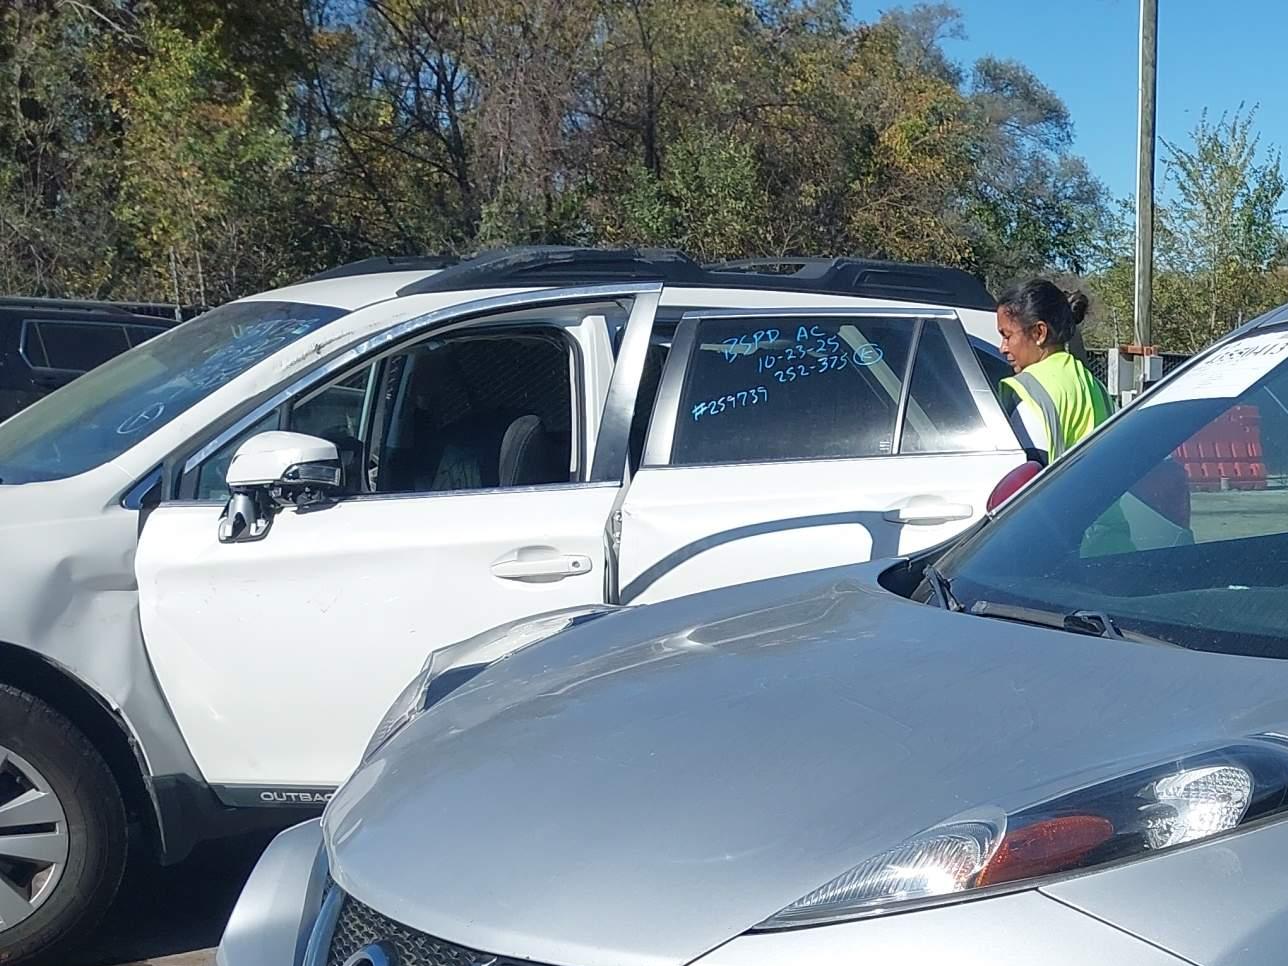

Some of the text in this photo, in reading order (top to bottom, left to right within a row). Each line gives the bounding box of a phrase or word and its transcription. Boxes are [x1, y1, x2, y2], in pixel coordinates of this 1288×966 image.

[758, 334, 840, 374] 10-23-25
[774, 352, 849, 383] 252-375
[691, 386, 768, 422] #259739
